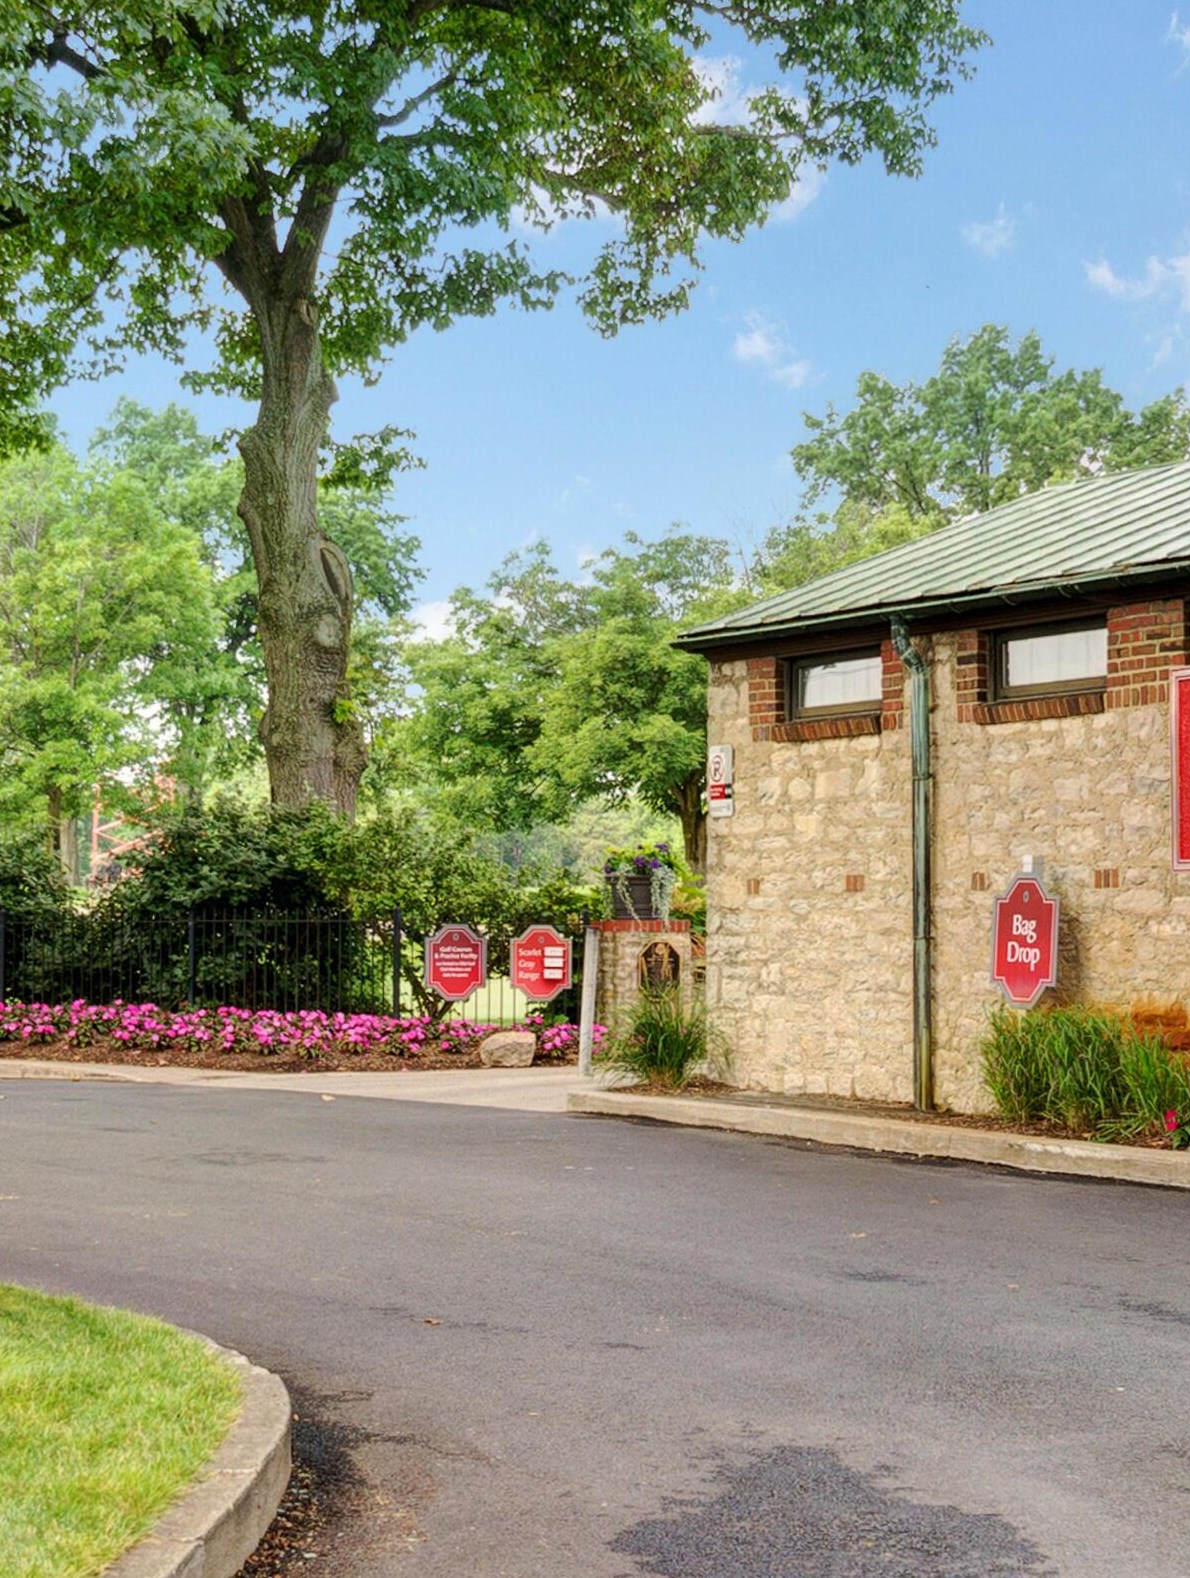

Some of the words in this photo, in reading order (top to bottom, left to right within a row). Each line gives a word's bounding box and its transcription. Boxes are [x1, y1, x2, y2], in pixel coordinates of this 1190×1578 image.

[1012, 914, 1037, 943] Bag
[518, 948, 542, 957] Scarlet
[1007, 941, 1041, 972] Drop
[518, 971, 541, 982] Range
